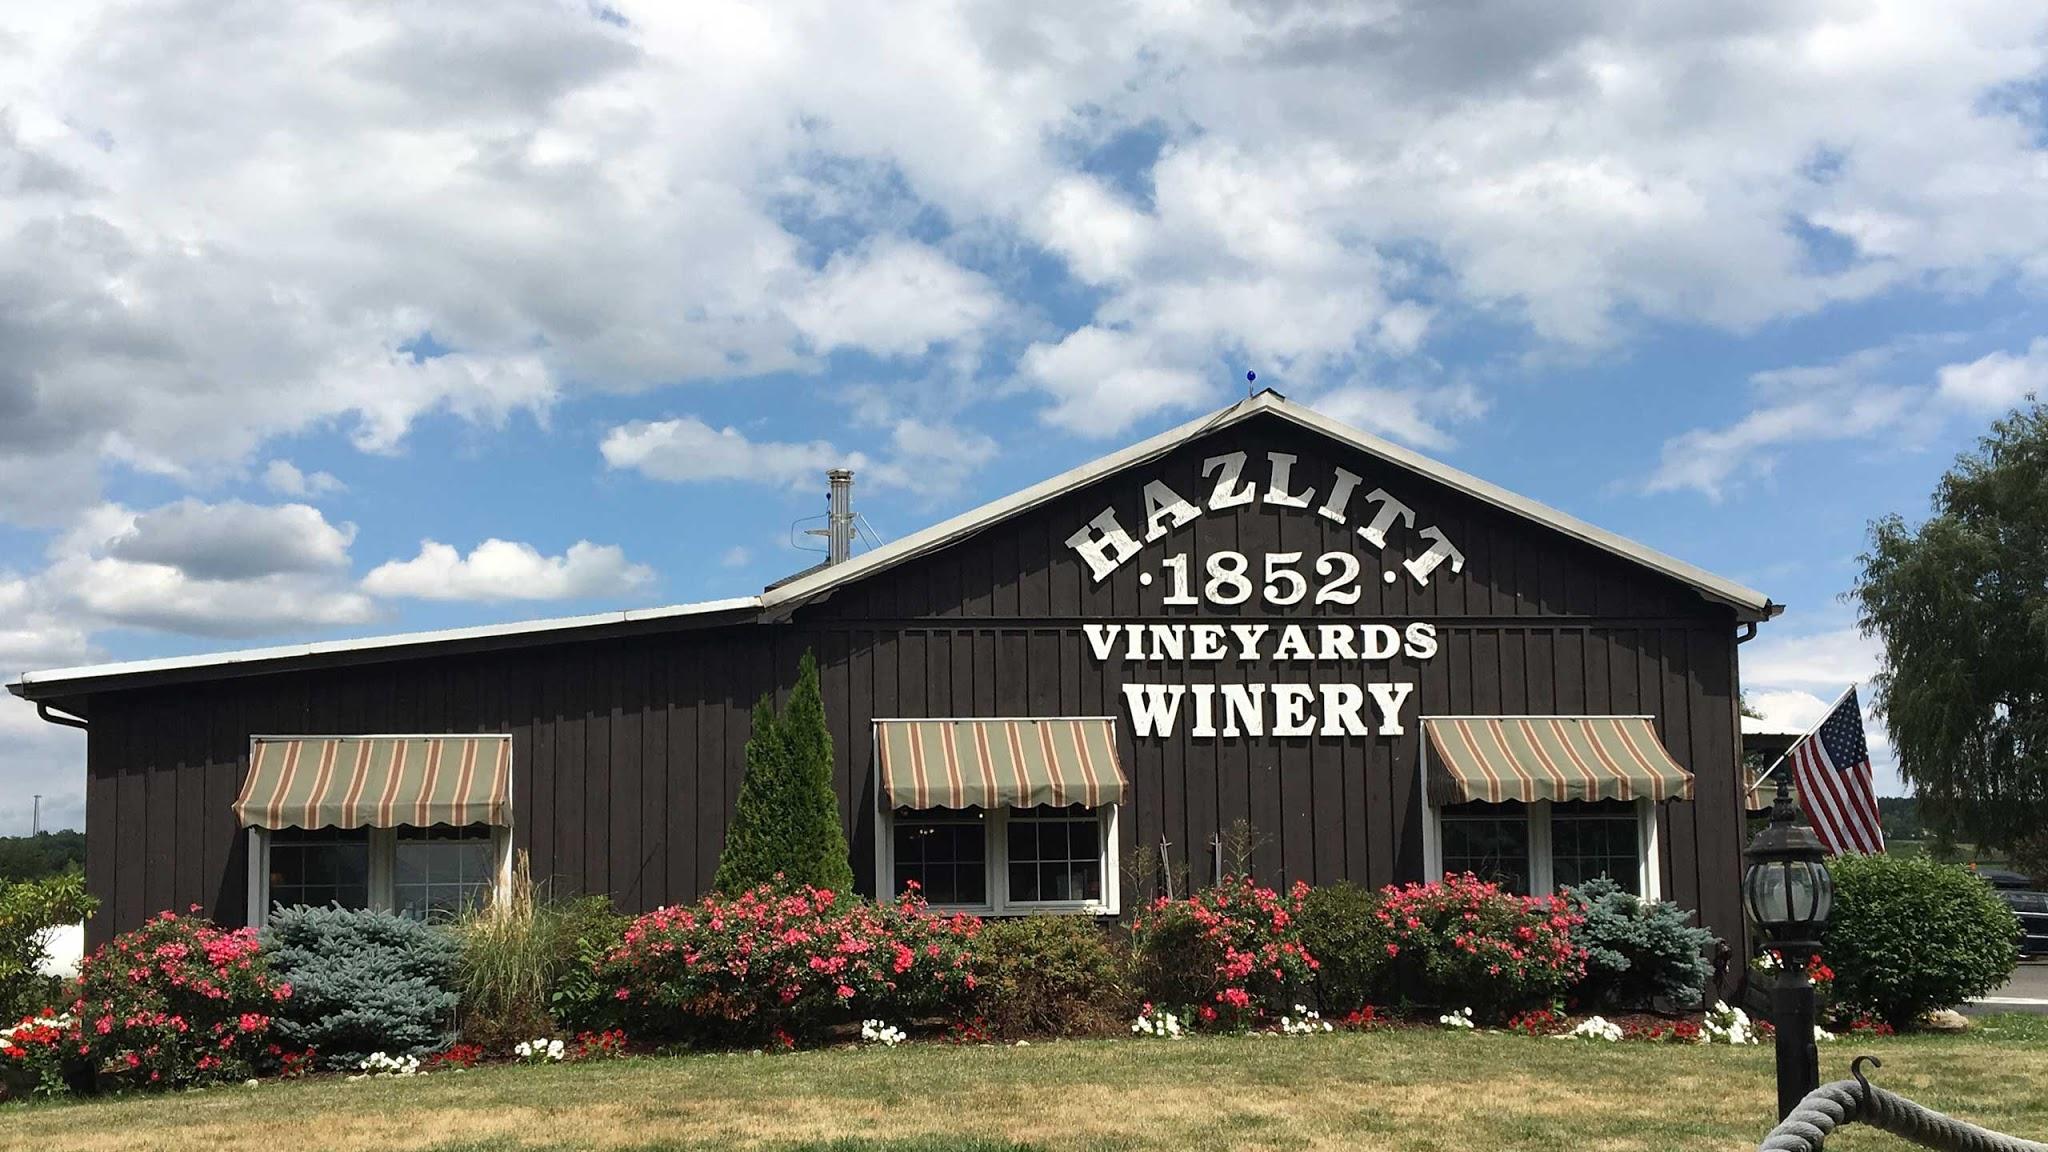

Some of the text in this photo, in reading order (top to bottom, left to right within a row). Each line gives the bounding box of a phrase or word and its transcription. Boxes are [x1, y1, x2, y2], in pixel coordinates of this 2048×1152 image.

[1065, 451, 1465, 587] HAZLITT
[1162, 551, 1362, 605] 1852
[1083, 622, 1438, 660] VINEYARDS
[1122, 683, 1414, 738] WINERY
